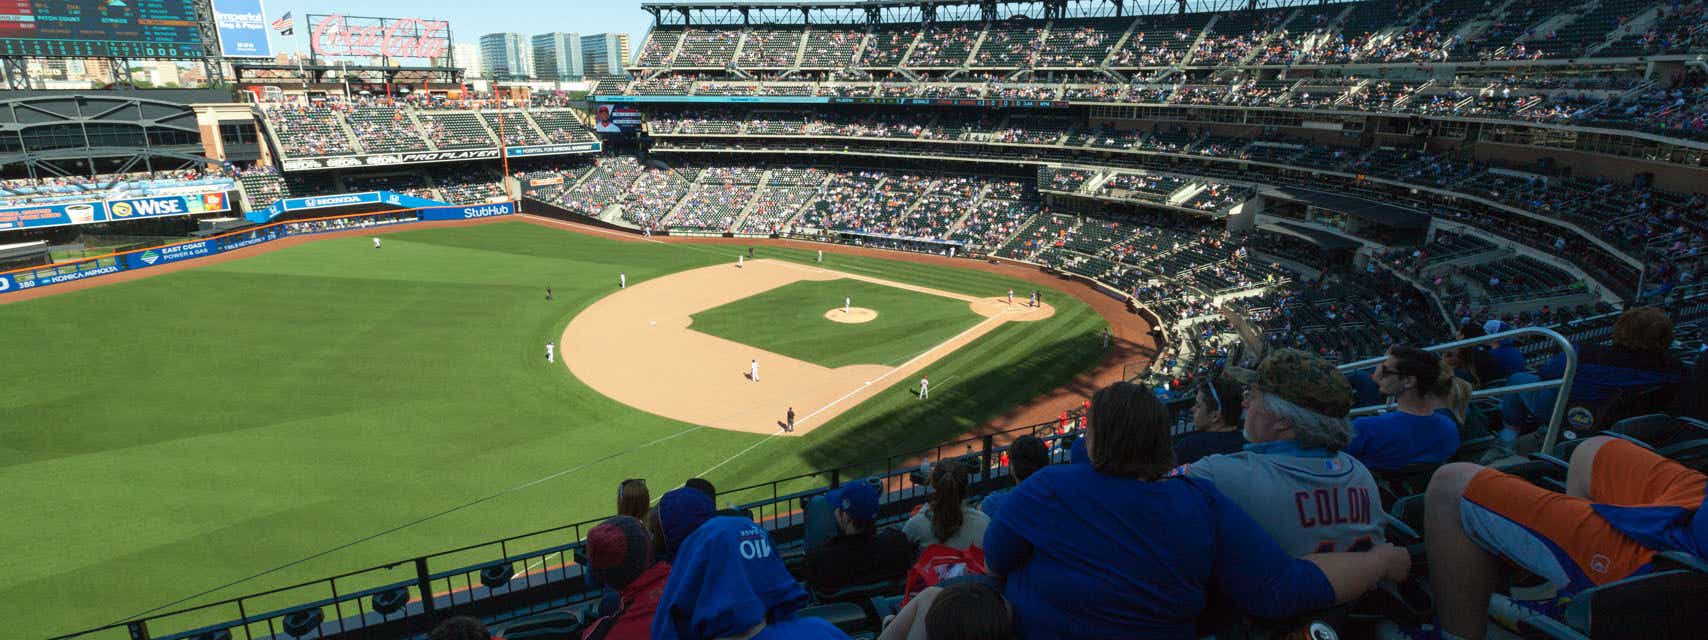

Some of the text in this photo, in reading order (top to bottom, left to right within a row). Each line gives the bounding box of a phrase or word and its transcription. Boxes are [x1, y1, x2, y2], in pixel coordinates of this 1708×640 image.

[403, 153, 436, 162] PRO
[440, 149, 498, 160] PLAYER
[317, 196, 361, 205] HONDA
[464, 205, 509, 218] StubHub
[162, 242, 206, 255] EAST COAST
[163, 251, 188, 260] POWER
[51, 265, 119, 283] KONICA MINOLTA
[1294, 487, 1371, 529] COLON
